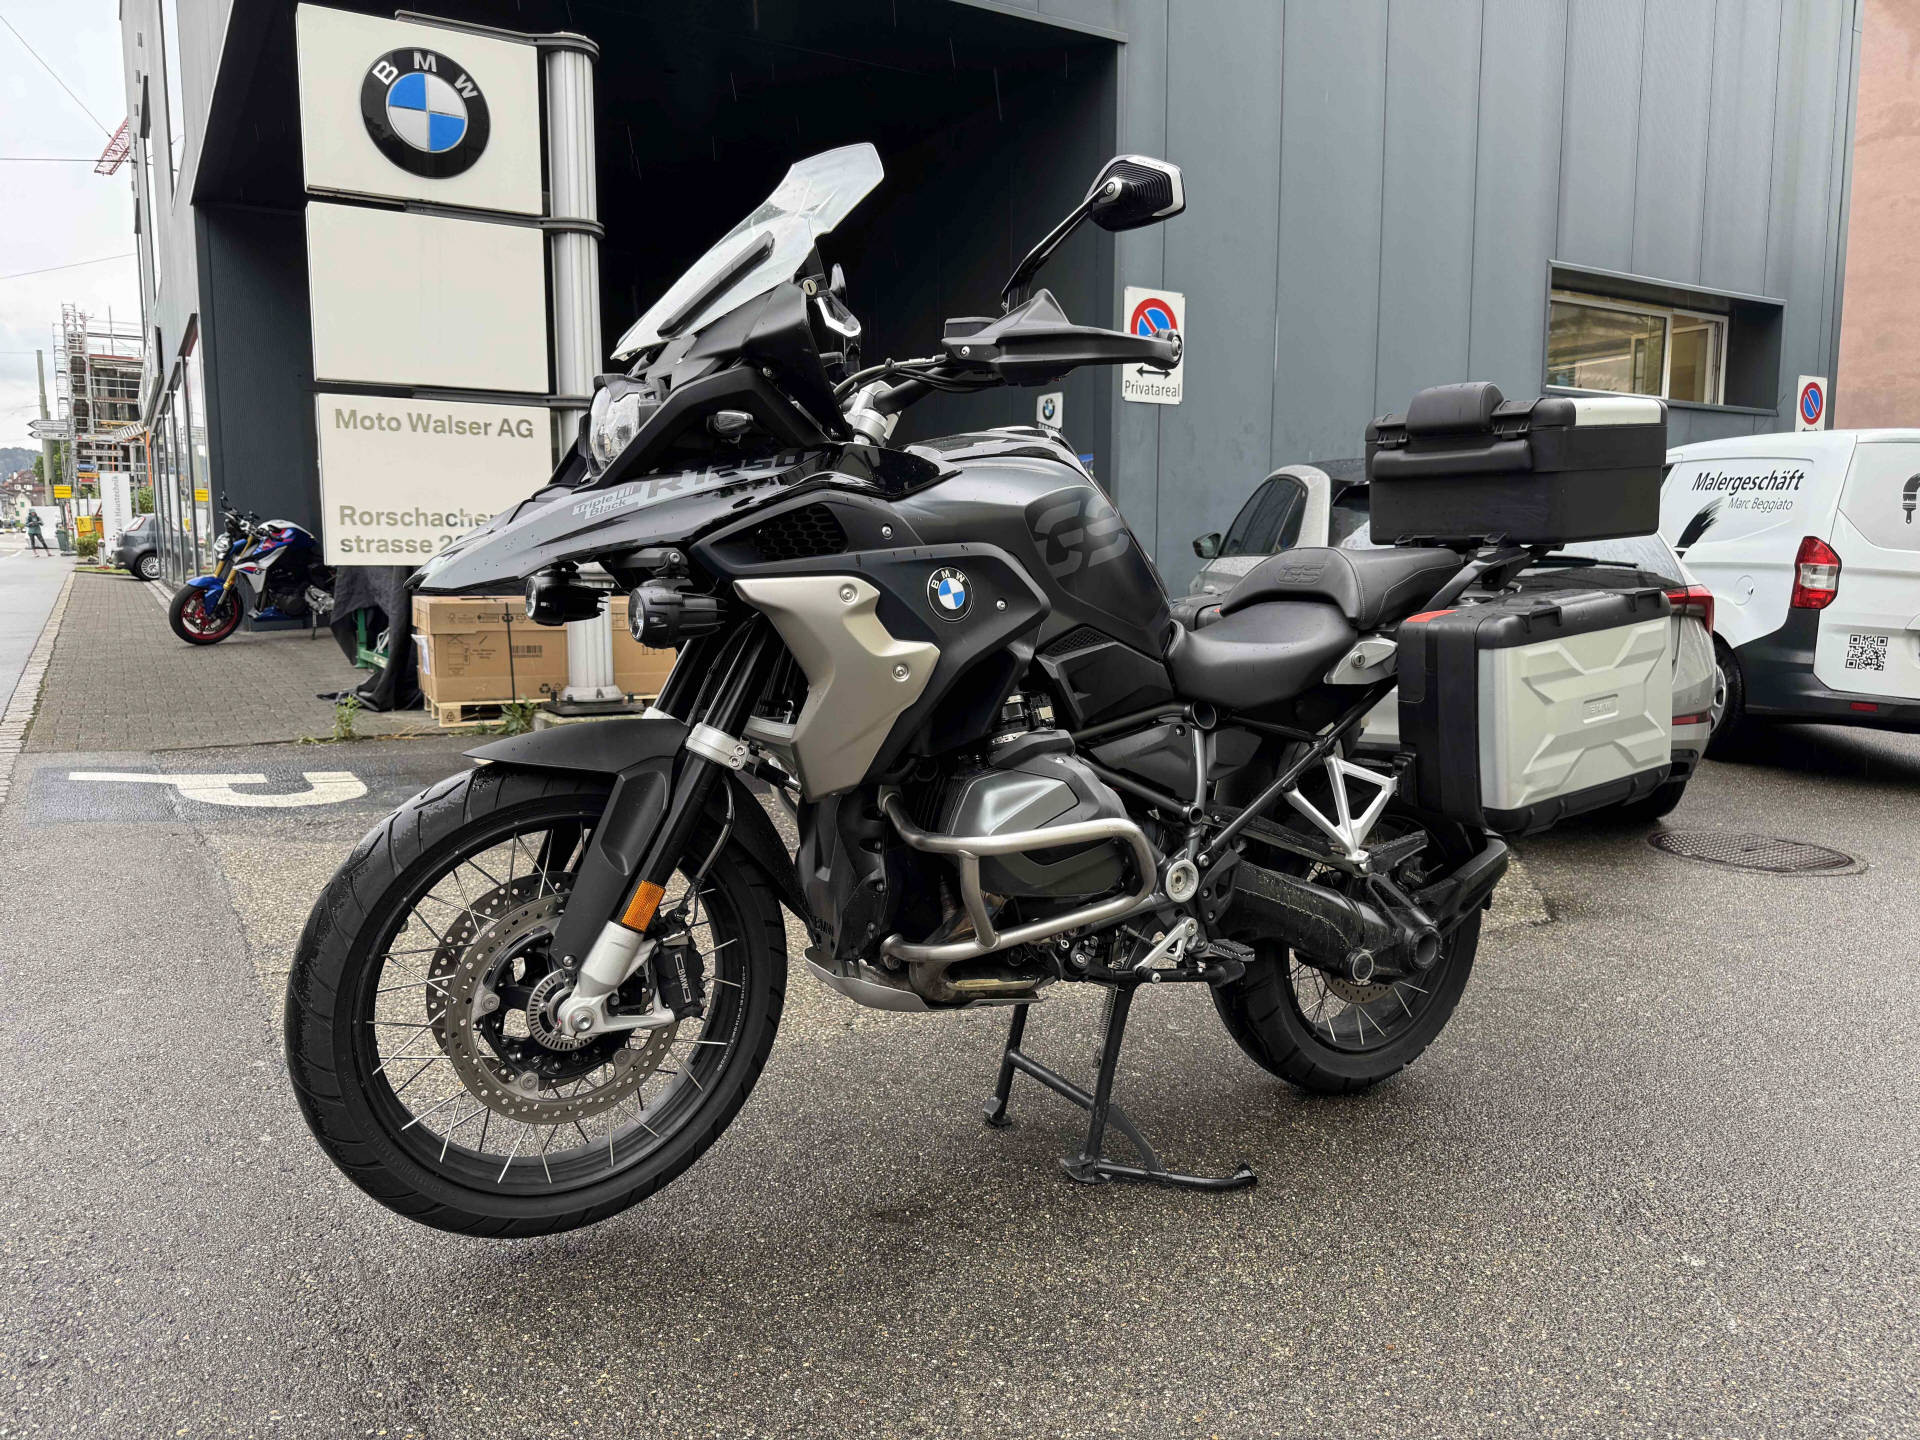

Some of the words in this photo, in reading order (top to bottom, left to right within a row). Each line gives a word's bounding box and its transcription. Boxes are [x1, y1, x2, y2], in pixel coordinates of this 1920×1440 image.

[372, 51, 480, 99] BMW
[1125, 380, 1180, 398] Privatareal
[335, 408, 401, 432] Moto
[407, 412, 492, 437] Walser
[497, 418, 534, 439] AG
[1692, 469, 1805, 496] Malergeschäft
[575, 493, 613, 513] Triple
[589, 498, 627, 516] Black
[1728, 498, 1751, 510] Marc
[1751, 498, 1793, 513] Beggiato
[340, 535, 433, 554] strasse
[930, 570, 965, 590] BMW
[679, 967, 690, 991] BMW
